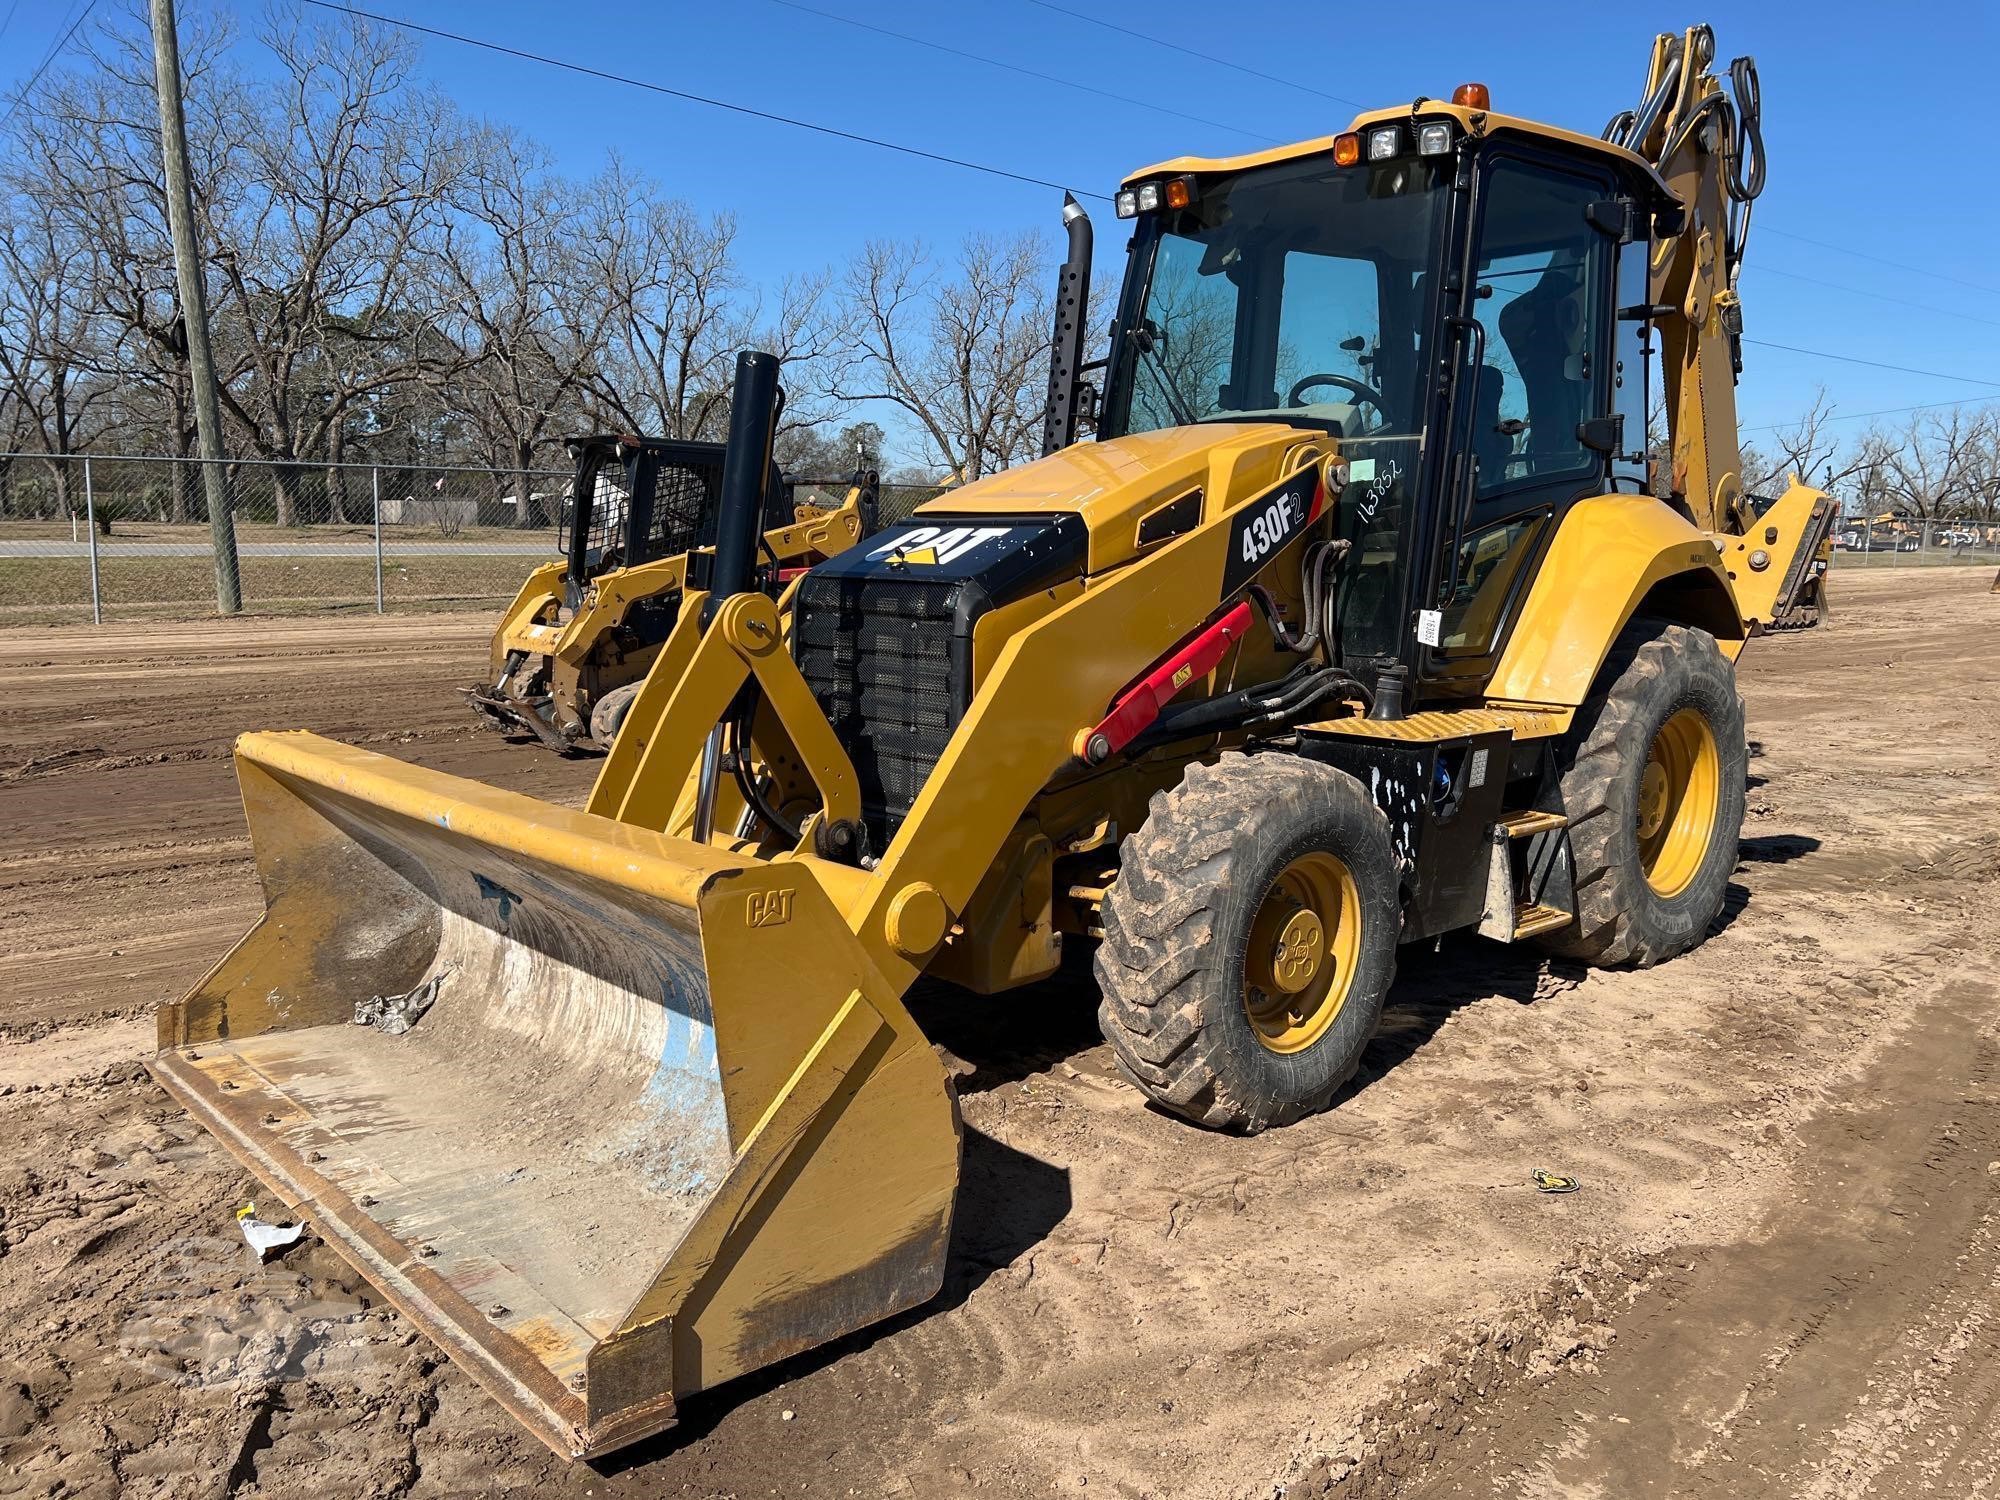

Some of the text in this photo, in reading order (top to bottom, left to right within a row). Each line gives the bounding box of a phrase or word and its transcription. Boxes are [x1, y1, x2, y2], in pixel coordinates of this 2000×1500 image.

[1357, 459, 1403, 524] 163852
[864, 527, 1013, 566] CAT
[1241, 491, 1305, 564] 430F2
[746, 888, 797, 928] CAT
